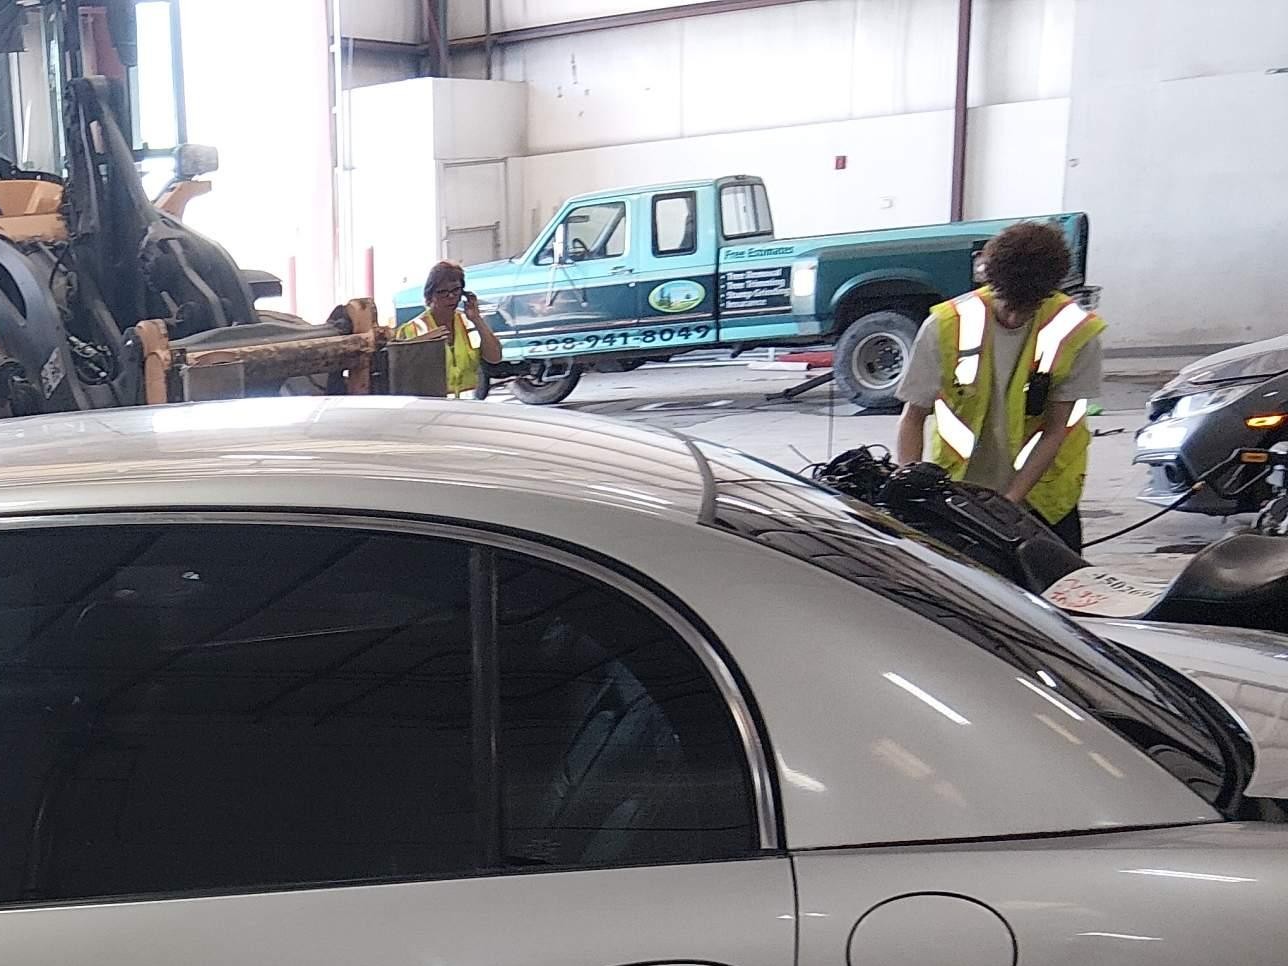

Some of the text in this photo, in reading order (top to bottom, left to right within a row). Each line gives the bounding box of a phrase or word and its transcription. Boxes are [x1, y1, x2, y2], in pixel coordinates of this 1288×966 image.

[724, 246, 794, 259] Free Estimates
[528, 324, 710, 353] 208-941-8049
